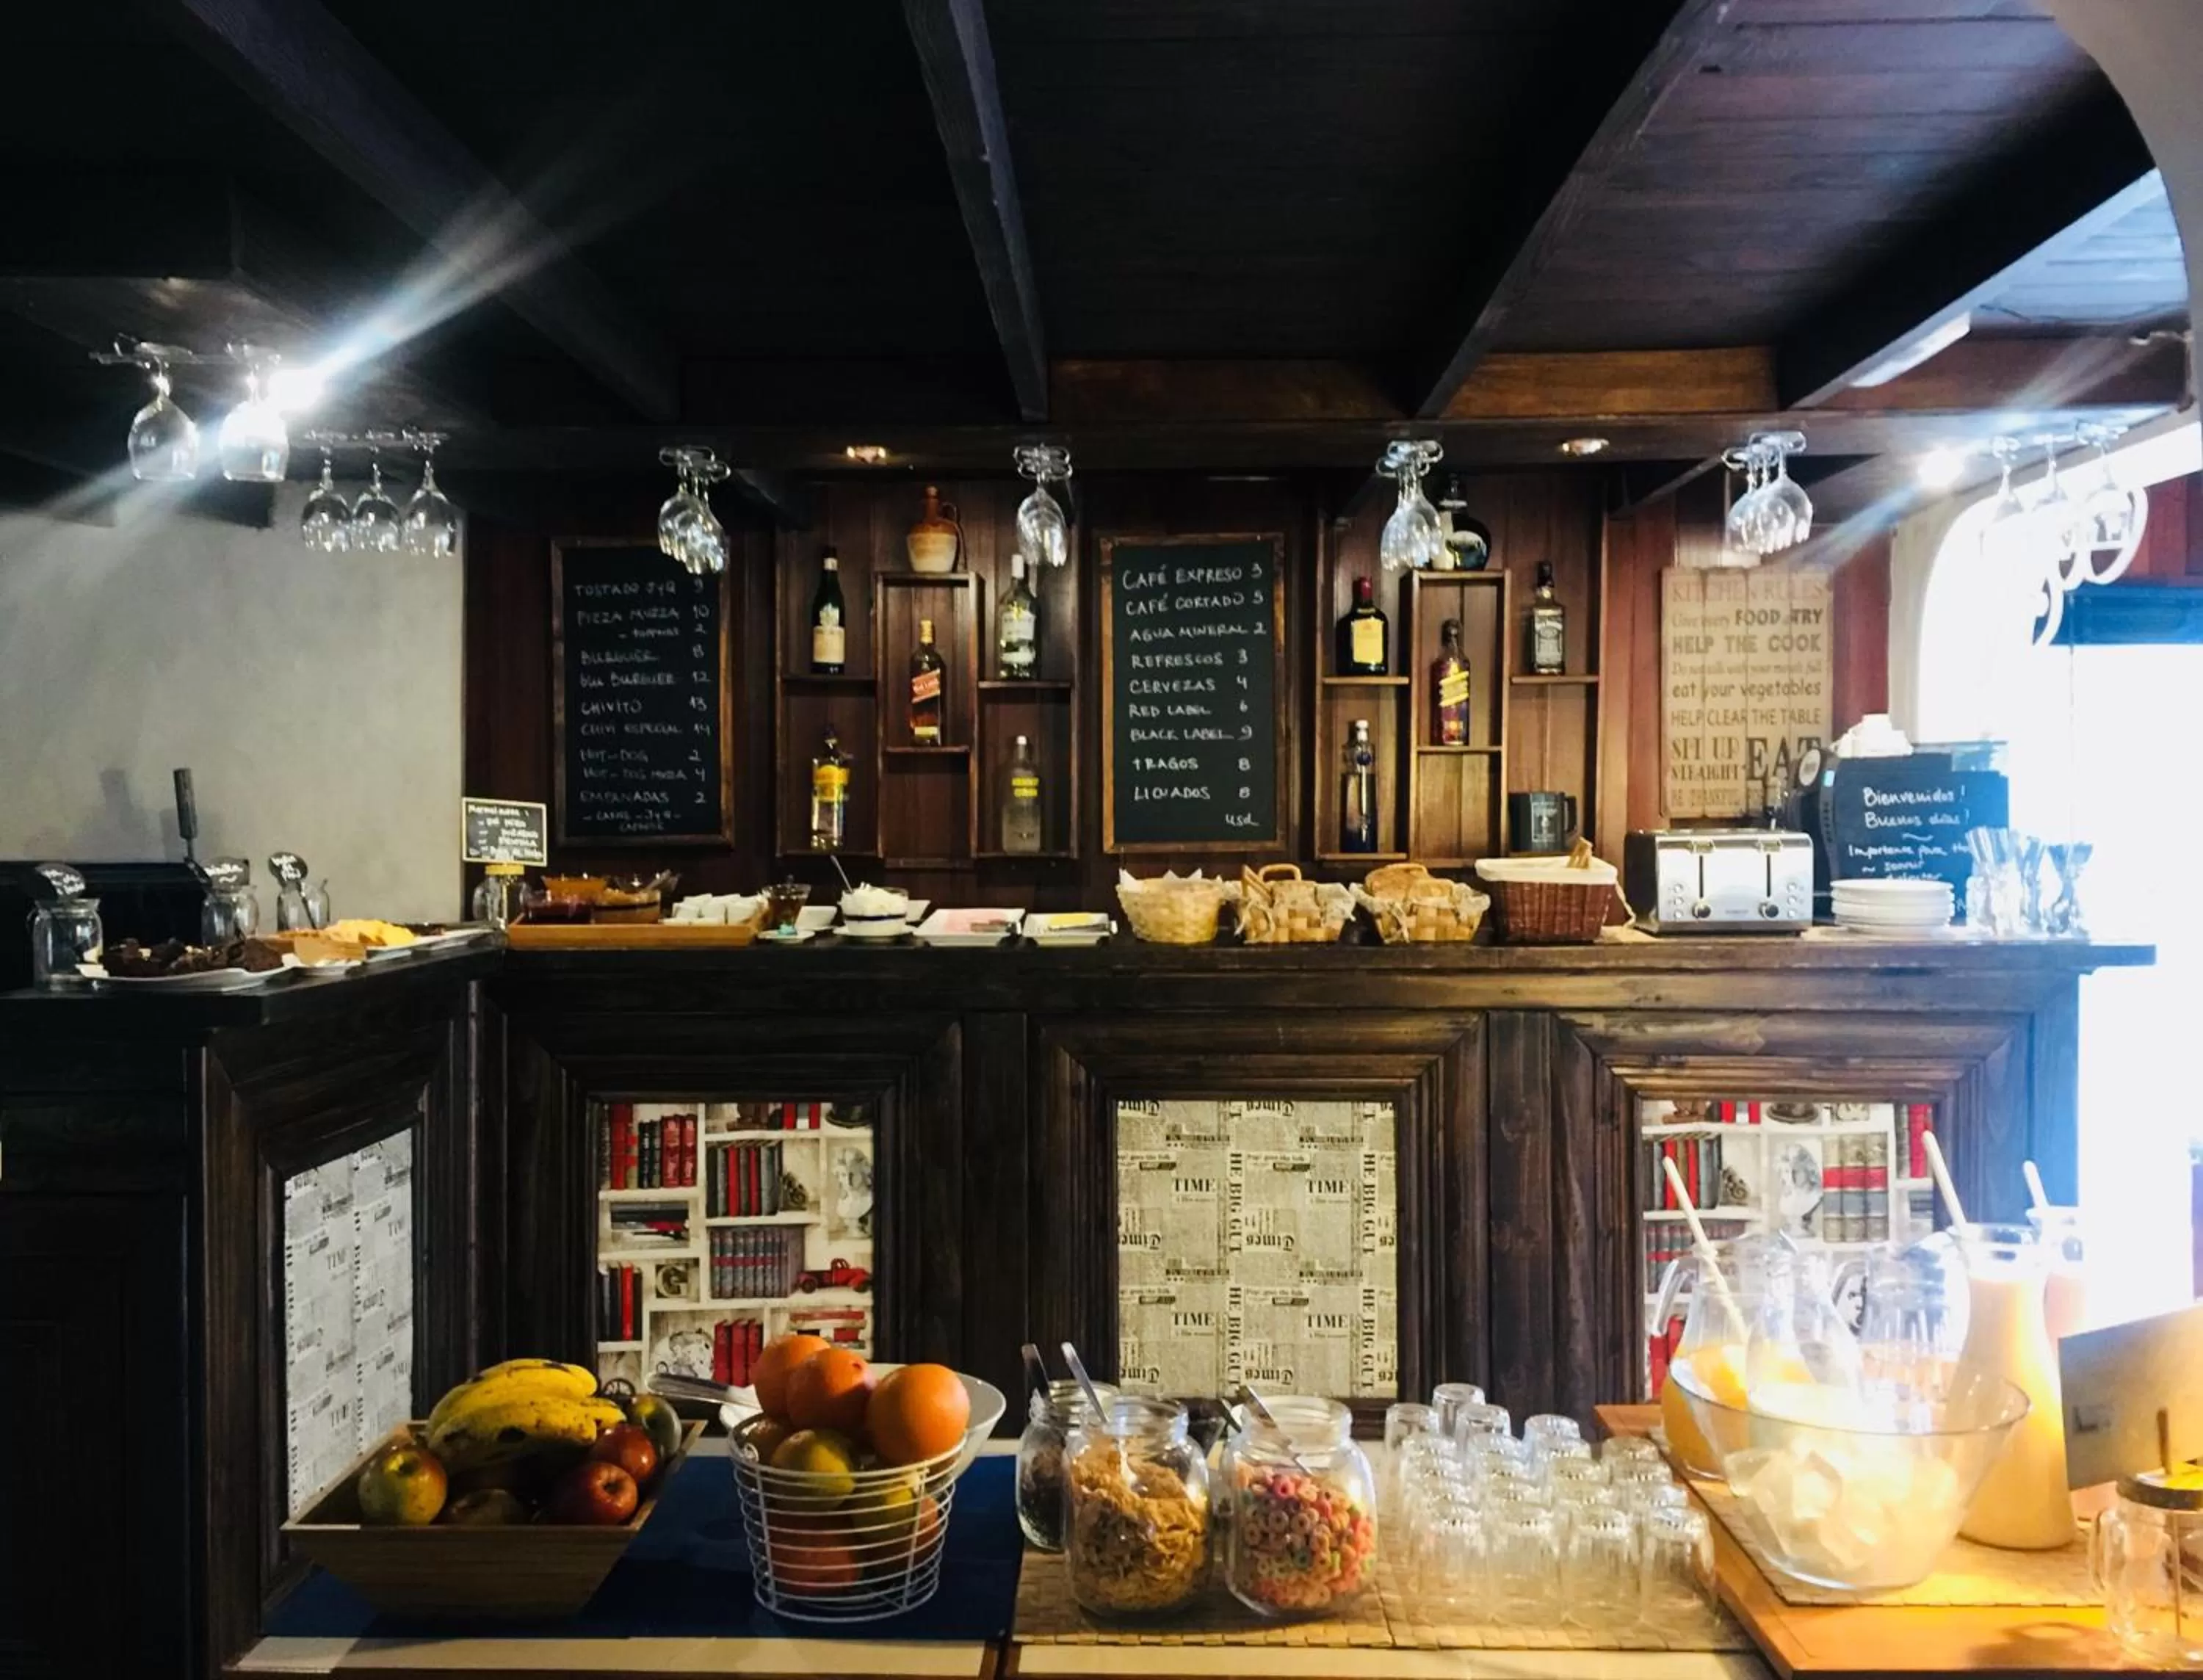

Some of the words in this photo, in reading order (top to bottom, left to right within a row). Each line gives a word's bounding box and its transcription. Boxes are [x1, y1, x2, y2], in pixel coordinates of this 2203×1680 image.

[1123, 564, 1167, 590] CAFÉ
[1176, 567, 1242, 584] EXPRESO
[692, 604, 709, 619] 10
[1126, 593, 1169, 615] CAFÉ
[1175, 592, 1245, 610] CORTADO
[1735, 609, 1781, 626] FOOD
[1790, 608, 1823, 625] TRY
[1129, 627, 1175, 642] AGUA
[1179, 623, 1248, 637] MINERAL
[1254, 621, 1267, 635] 2
[1673, 635, 1714, 653] HELP
[1725, 634, 1758, 653] THE
[1768, 633, 1821, 653] COOK
[1131, 652, 1223, 669] REFRESCOS
[1237, 648, 1248, 665] 3
[692, 670, 711, 684] 12
[1129, 678, 1216, 694] CERVEZAS
[1236, 675, 1248, 690] 4
[1672, 682, 1696, 698] eat
[1702, 684, 1735, 703] your
[1740, 680, 1822, 702] vegetables
[1129, 703, 1160, 718] RED
[1167, 704, 1212, 716] LABEL
[1240, 699, 1248, 712] 6
[1671, 710, 1704, 726] HELP
[1707, 709, 1748, 725] CLEAR
[1751, 708, 1777, 725] THE
[1781, 708, 1821, 725] TABLE
[1130, 728, 1179, 742] BLACK
[1183, 728, 1234, 741] LABEL
[1672, 737, 1701, 760] SIT
[1712, 736, 1740, 760] UP
[1132, 757, 1199, 771] TRAGOS
[694, 768, 706, 782] 4
[694, 791, 708, 805] 2
[1230, 1152, 1242, 1178] HE
[1363, 1154, 1375, 1178] HE
[1173, 1178, 1215, 1192] TIME
[1307, 1180, 1349, 1194] TIME
[1230, 1182, 1242, 1212] BIG
[1363, 1184, 1375, 1214] BIG
[1230, 1218, 1242, 1253] GUT
[1246, 1235, 1295, 1251] Times
[1363, 1220, 1375, 1256] GUT
[1229, 1286, 1242, 1311] HE
[1362, 1289, 1375, 1313] HE
[1173, 1312, 1215, 1326] TIME
[1306, 1314, 1348, 1328] TIME
[1229, 1316, 1242, 1347] BIG
[1362, 1319, 1375, 1349] BIG
[1229, 1352, 1242, 1386] GUT
[1245, 1369, 1293, 1385] Times
[1362, 1354, 1375, 1389] GUT
